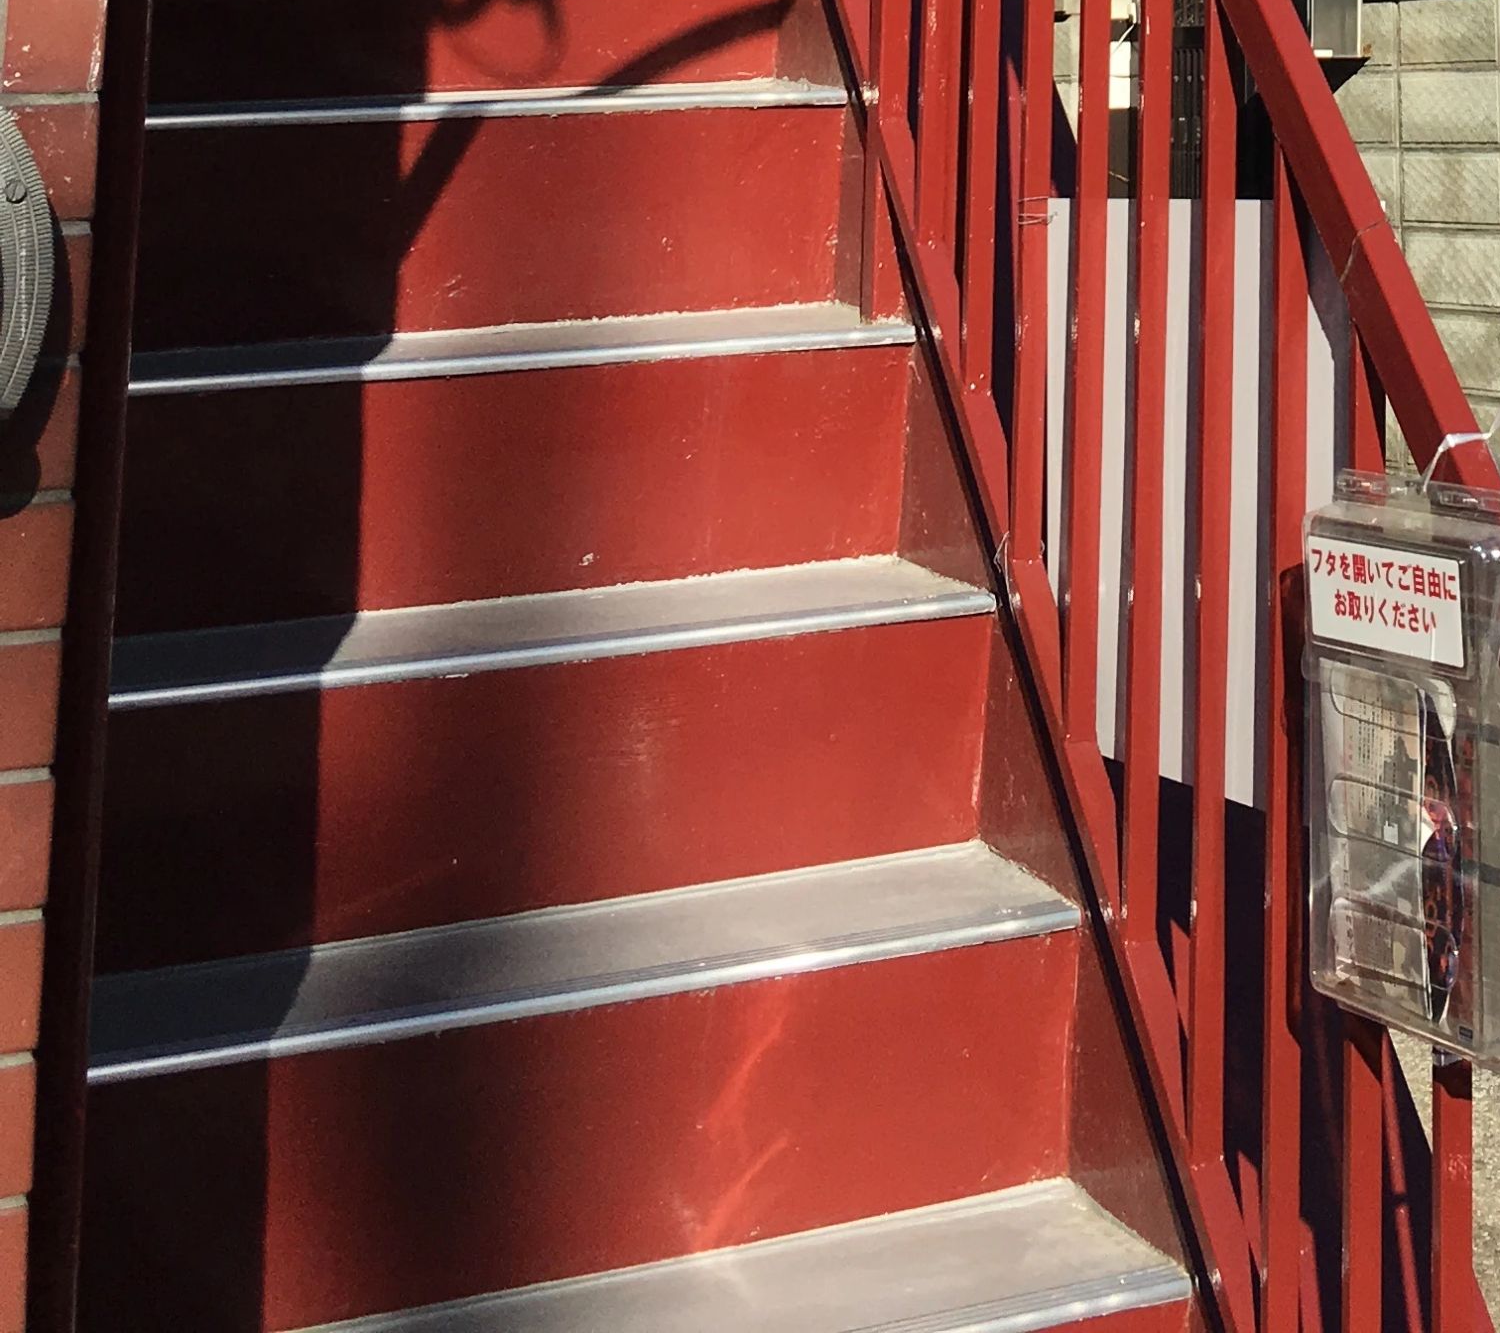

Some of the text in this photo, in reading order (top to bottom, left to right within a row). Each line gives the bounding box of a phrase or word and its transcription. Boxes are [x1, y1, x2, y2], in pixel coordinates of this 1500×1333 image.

[1311, 548, 1457, 601] フタを開いてご自由に
[1334, 588, 1437, 634] お取りください
